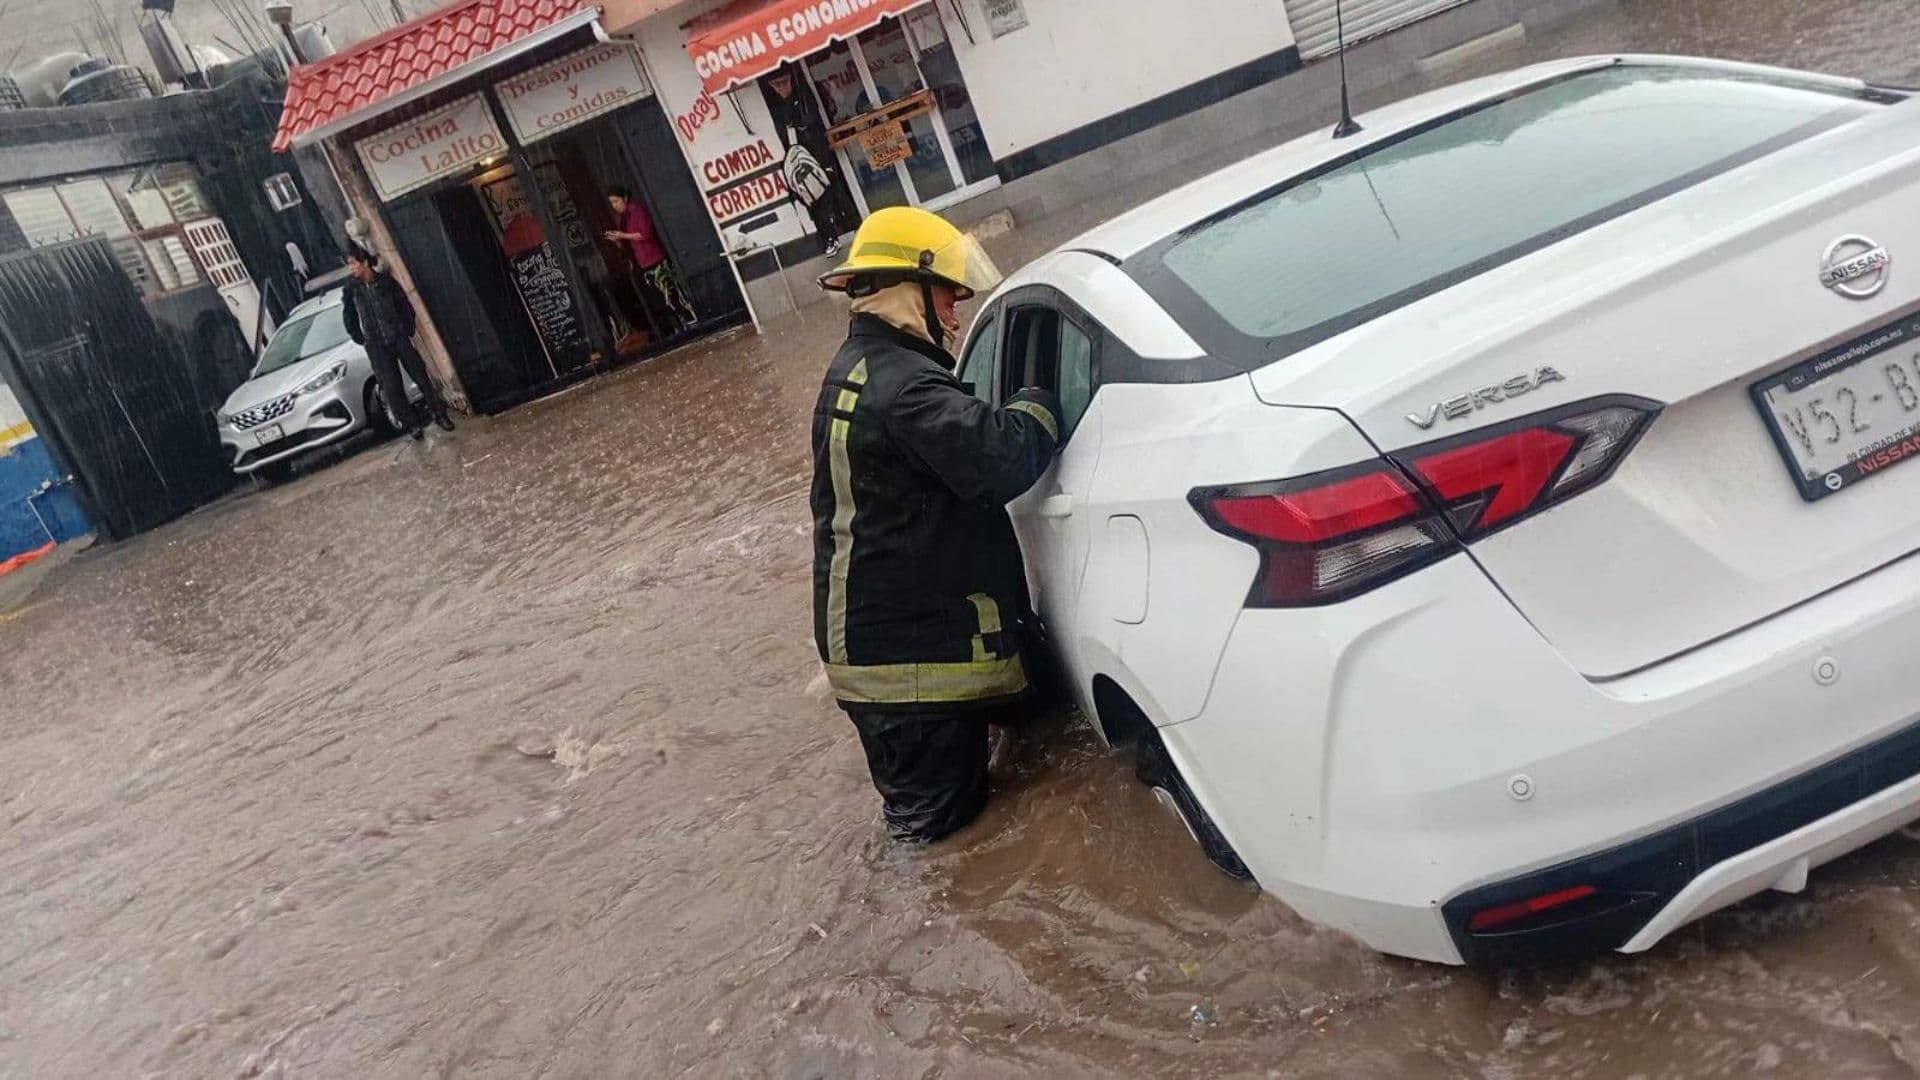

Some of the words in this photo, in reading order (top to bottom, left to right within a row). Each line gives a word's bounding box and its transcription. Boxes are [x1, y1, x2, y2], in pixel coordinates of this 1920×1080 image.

[695, 31, 767, 79] COCINA
[766, 0, 877, 48] ECONOMI
[507, 45, 624, 100] Desayunos
[566, 83, 579, 99] y
[536, 86, 628, 128] Comidas
[369, 116, 459, 164] Cocina
[421, 132, 497, 173] Lalito
[1830, 251, 1886, 281] NISSAN
[1404, 366, 1566, 430] VERSA
